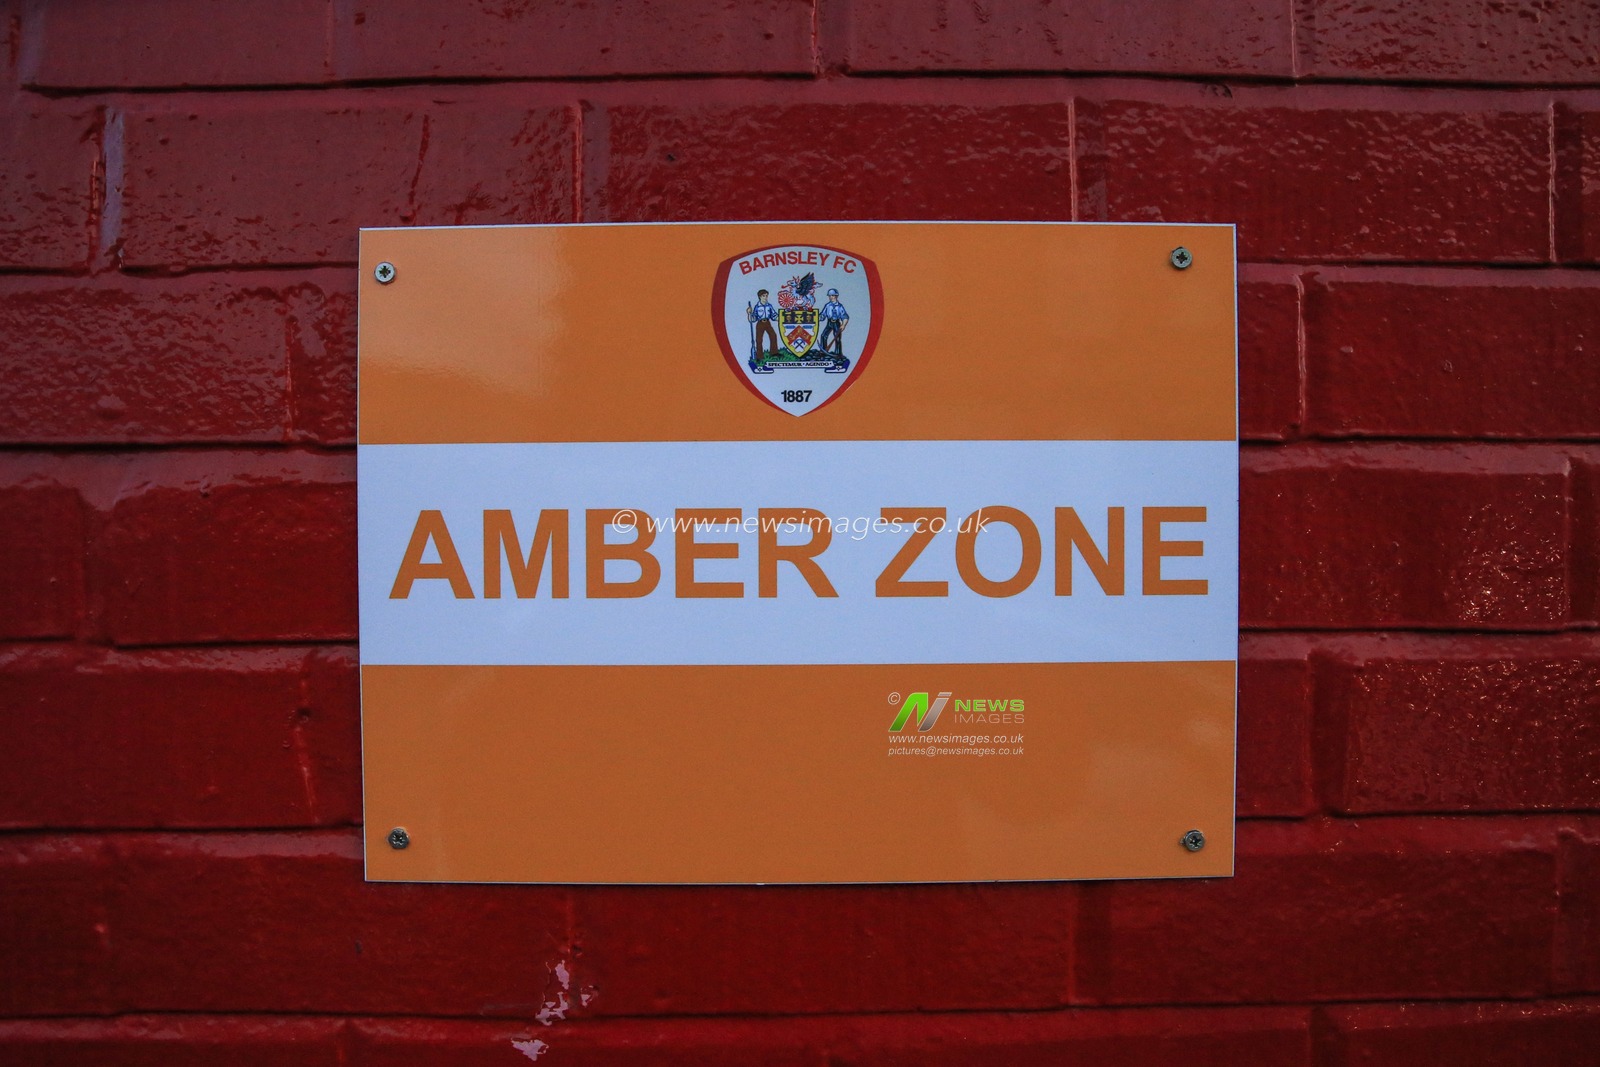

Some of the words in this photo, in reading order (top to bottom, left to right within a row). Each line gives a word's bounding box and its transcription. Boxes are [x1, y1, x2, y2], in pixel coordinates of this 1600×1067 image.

[738, 251, 830, 275] BARNSLEY
[833, 255, 857, 274] FC
[781, 390, 813, 403] 1887
[388, 507, 839, 600] AMBER
[875, 505, 1209, 599] ZONE
